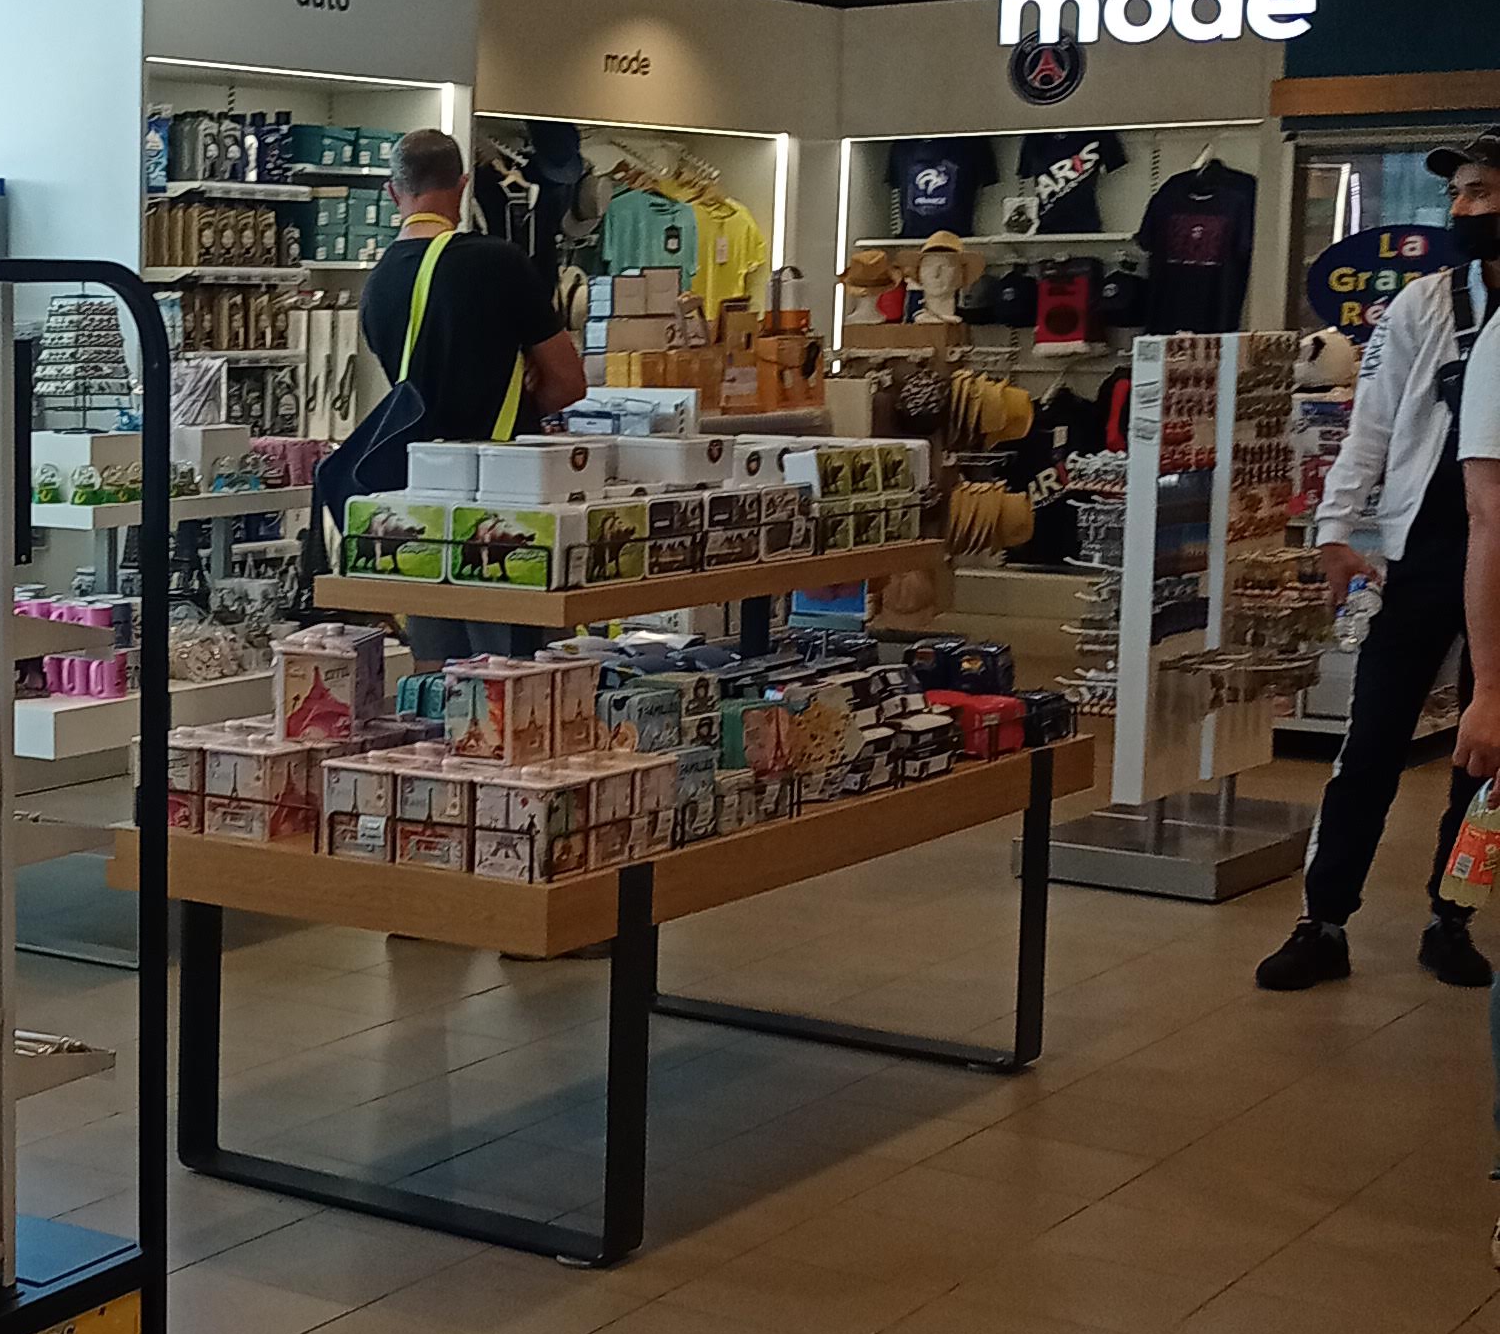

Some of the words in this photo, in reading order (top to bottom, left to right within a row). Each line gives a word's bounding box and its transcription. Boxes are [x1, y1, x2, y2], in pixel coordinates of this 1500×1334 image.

[603, 48, 652, 77] mode
[1036, 141, 1100, 204] ARIS
[1378, 232, 1428, 259] La
[1327, 265, 1450, 294] Gran
